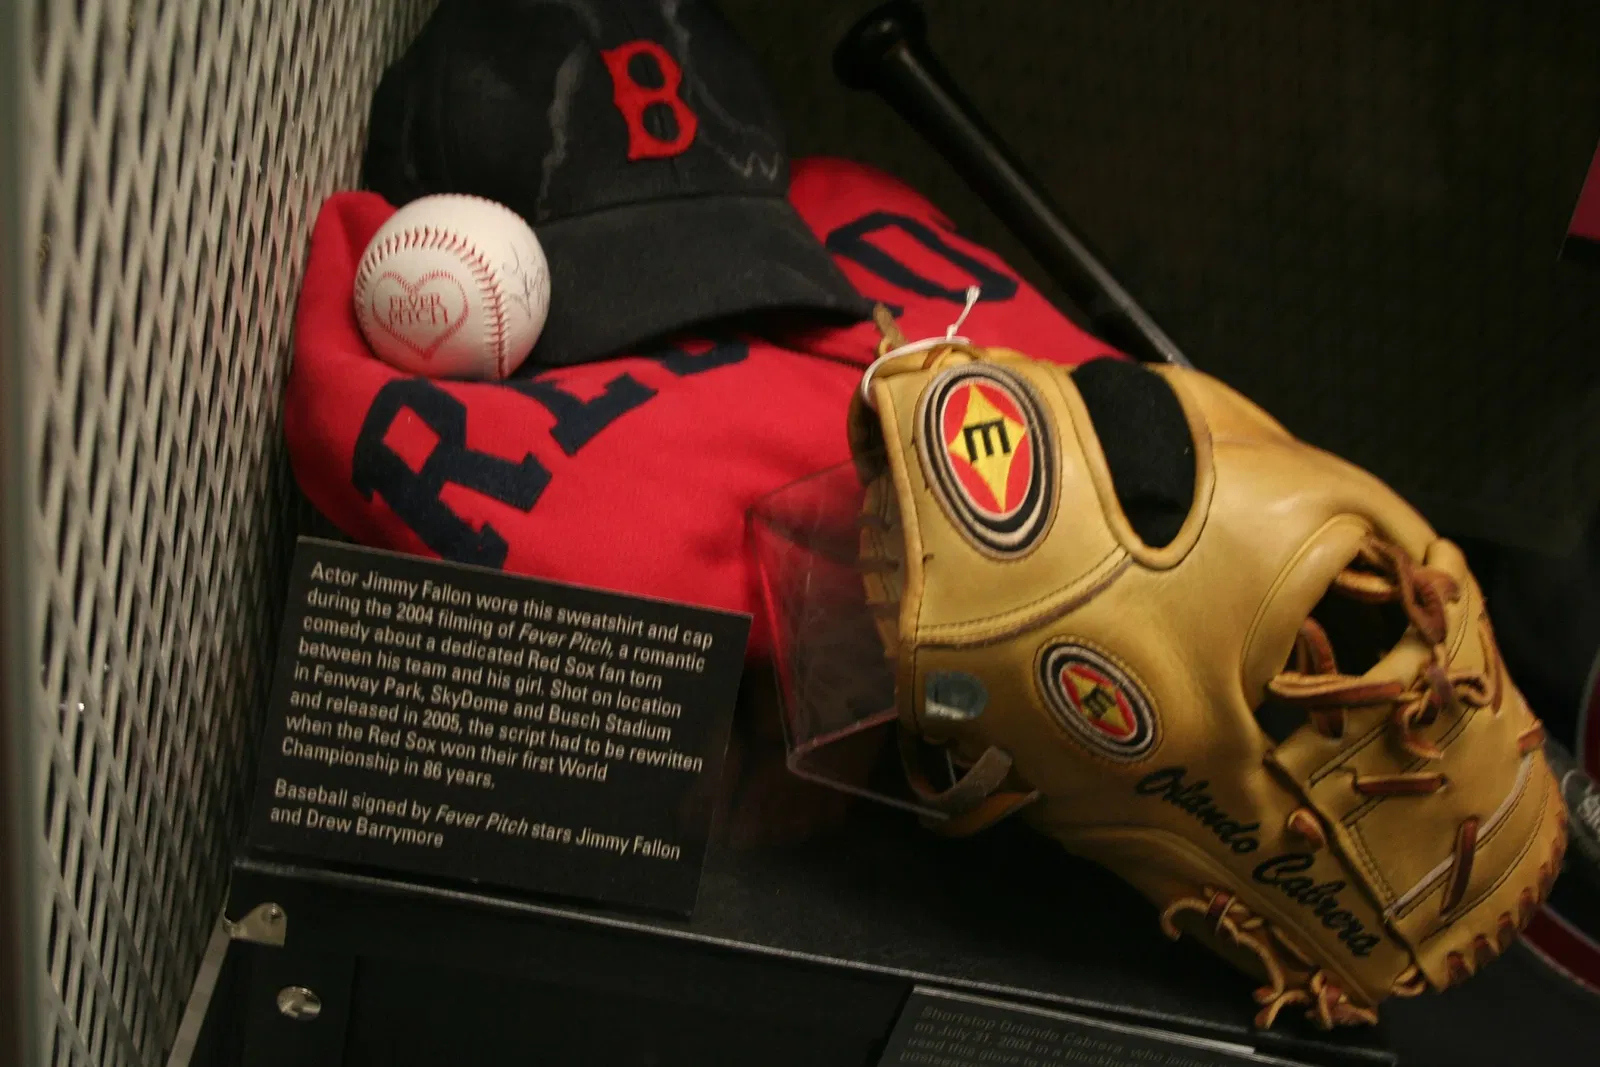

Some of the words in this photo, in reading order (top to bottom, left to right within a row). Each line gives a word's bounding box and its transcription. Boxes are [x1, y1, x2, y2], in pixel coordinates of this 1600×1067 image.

[601, 40, 697, 160] B
[308, 588, 360, 618] during
[366, 597, 392, 618] the
[396, 602, 434, 626] 2004
[438, 610, 493, 640] filming
[498, 621, 516, 639] of
[519, 622, 566, 648] Fever
[568, 632, 614, 660] Pitch,
[619, 644, 628, 660] a
[634, 646, 706, 674] romantic
[310, 561, 358, 587] Actor
[362, 570, 418, 598] Jimmy
[422, 580, 472, 607] Fallon
[476, 593, 518, 614] wore
[524, 600, 552, 620] this
[557, 607, 644, 638] sweatshirt
[648, 623, 678, 644] and
[682, 630, 713, 652] cap
[299, 636, 372, 666] between
[376, 649, 400, 672] his
[406, 656, 446, 679] team
[452, 666, 484, 686] and
[487, 670, 510, 688] his
[550, 678, 588, 700] Shot
[592, 690, 612, 708] on
[616, 690, 682, 719] location
[303, 614, 370, 644] comedy
[374, 625, 422, 650] about
[426, 636, 435, 651] a
[442, 636, 524, 665] dedicated
[528, 650, 560, 674] Red
[564, 656, 595, 680] Sox
[600, 662, 625, 684] fan
[630, 668, 662, 691] torn
[290, 690, 322, 710] and
[326, 696, 400, 722] released
[404, 705, 418, 726] in
[468, 717, 494, 738] the
[500, 724, 546, 748] script
[550, 729, 580, 752] had
[584, 736, 600, 756] to
[605, 738, 625, 760] be
[630, 746, 703, 773] rewritten
[294, 661, 310, 682] in
[314, 664, 380, 697] Fenway
[384, 676, 425, 703] Park,
[431, 684, 508, 714] SkyDome
[514, 702, 544, 720] and
[548, 703, 600, 730] Busch
[605, 712, 672, 742] Stadium
[282, 736, 399, 776] Championship
[404, 756, 418, 776] in
[423, 760, 442, 779] 86
[286, 714, 332, 737] when
[337, 722, 363, 742] the
[368, 724, 400, 748] Red
[405, 731, 436, 754] Sox
[440, 741, 475, 761] won
[481, 744, 518, 767] their
[522, 750, 555, 773] first
[558, 756, 608, 782] World
[270, 806, 301, 825] and
[306, 808, 352, 833] Drew
[356, 816, 444, 848] Barrymore
[274, 778, 348, 806] Baseball
[352, 792, 408, 817] signed
[412, 800, 432, 824] by
[436, 804, 484, 828] Fever
[486, 812, 528, 836] Pitch
[532, 822, 572, 843] stars
[576, 828, 630, 856] Jimmy
[633, 836, 681, 862] Fallon
[1135, 767, 1260, 853] Orlando
[1252, 854, 1380, 957] Cabrera
[914, 1022, 934, 1034] on
[937, 1026, 970, 1042] July
[998, 1036, 1032, 1051] 2004
[921, 1004, 996, 1030] Shortstop
[1000, 1020, 1059, 1042] Orlando
